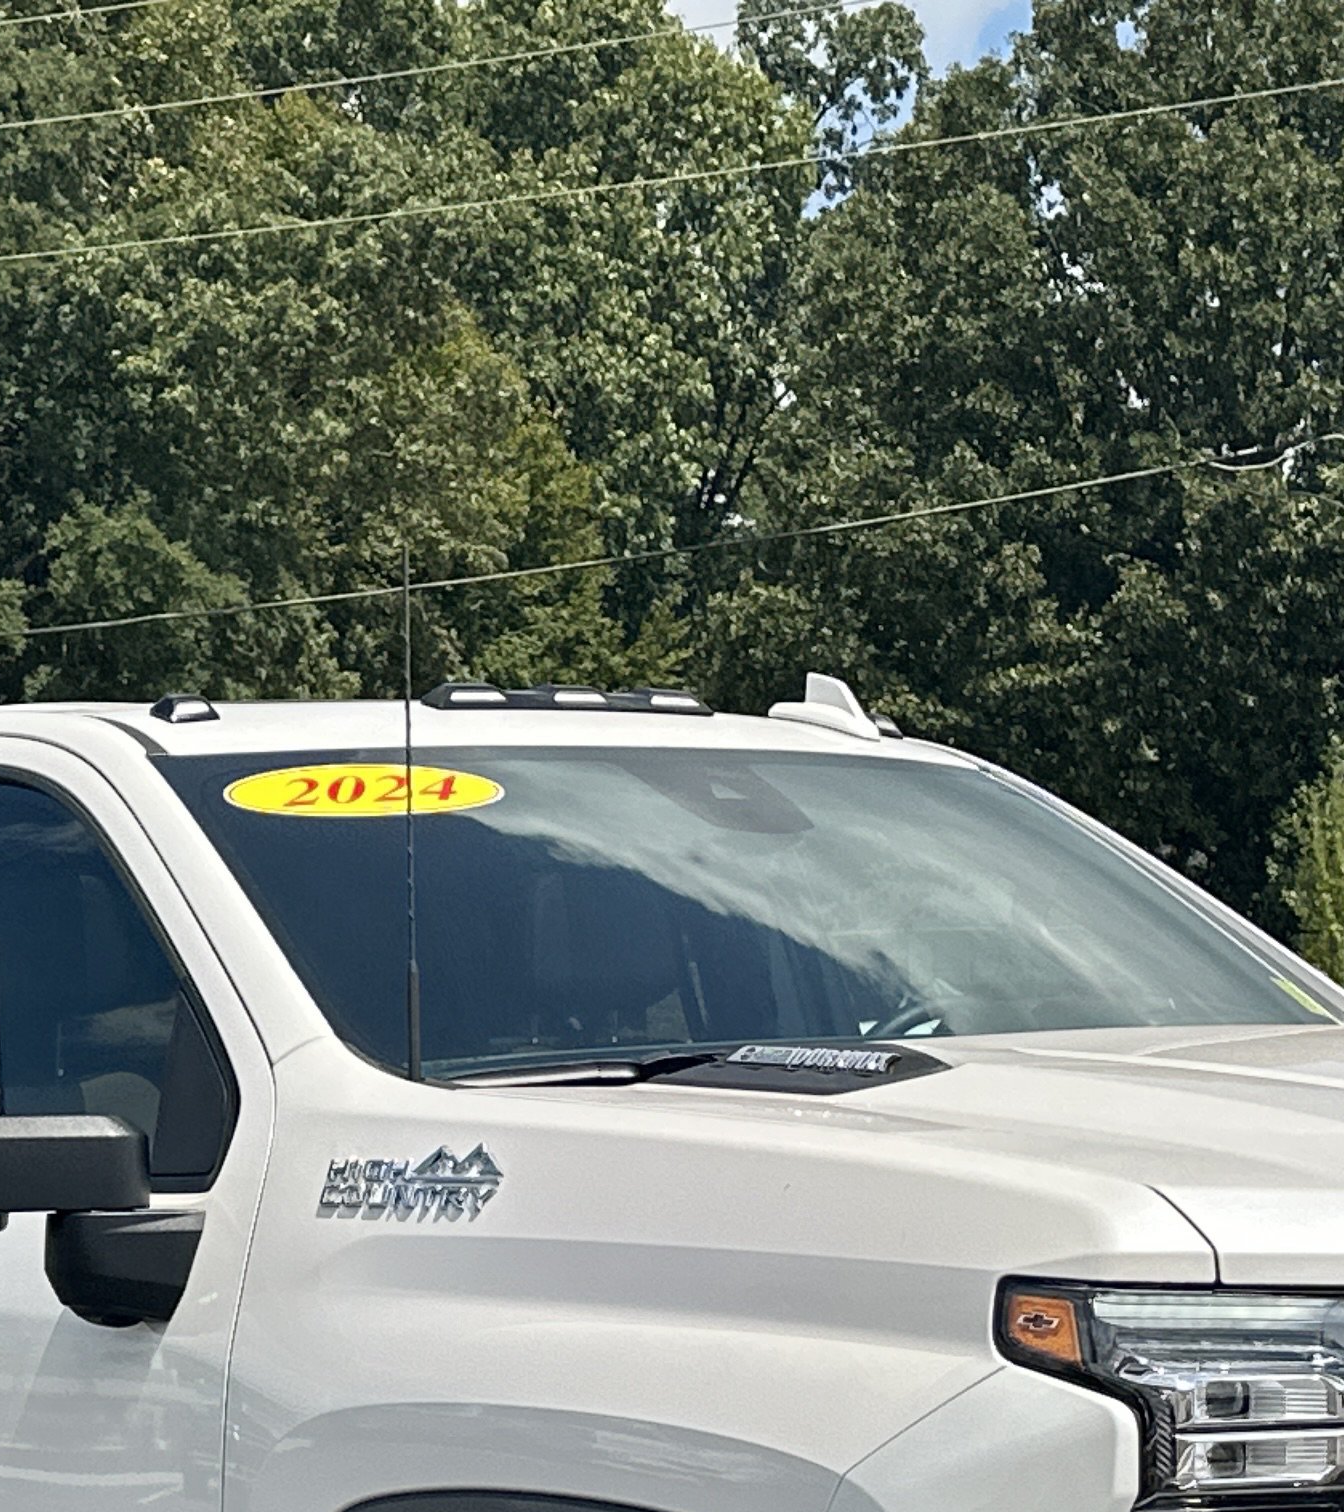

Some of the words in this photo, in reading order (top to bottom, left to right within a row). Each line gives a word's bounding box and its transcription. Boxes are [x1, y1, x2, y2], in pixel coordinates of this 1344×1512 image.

[283, 774, 458, 808] 2024
[326, 1158, 413, 1183] HIGH
[319, 1184, 498, 1215] COUNTRY
